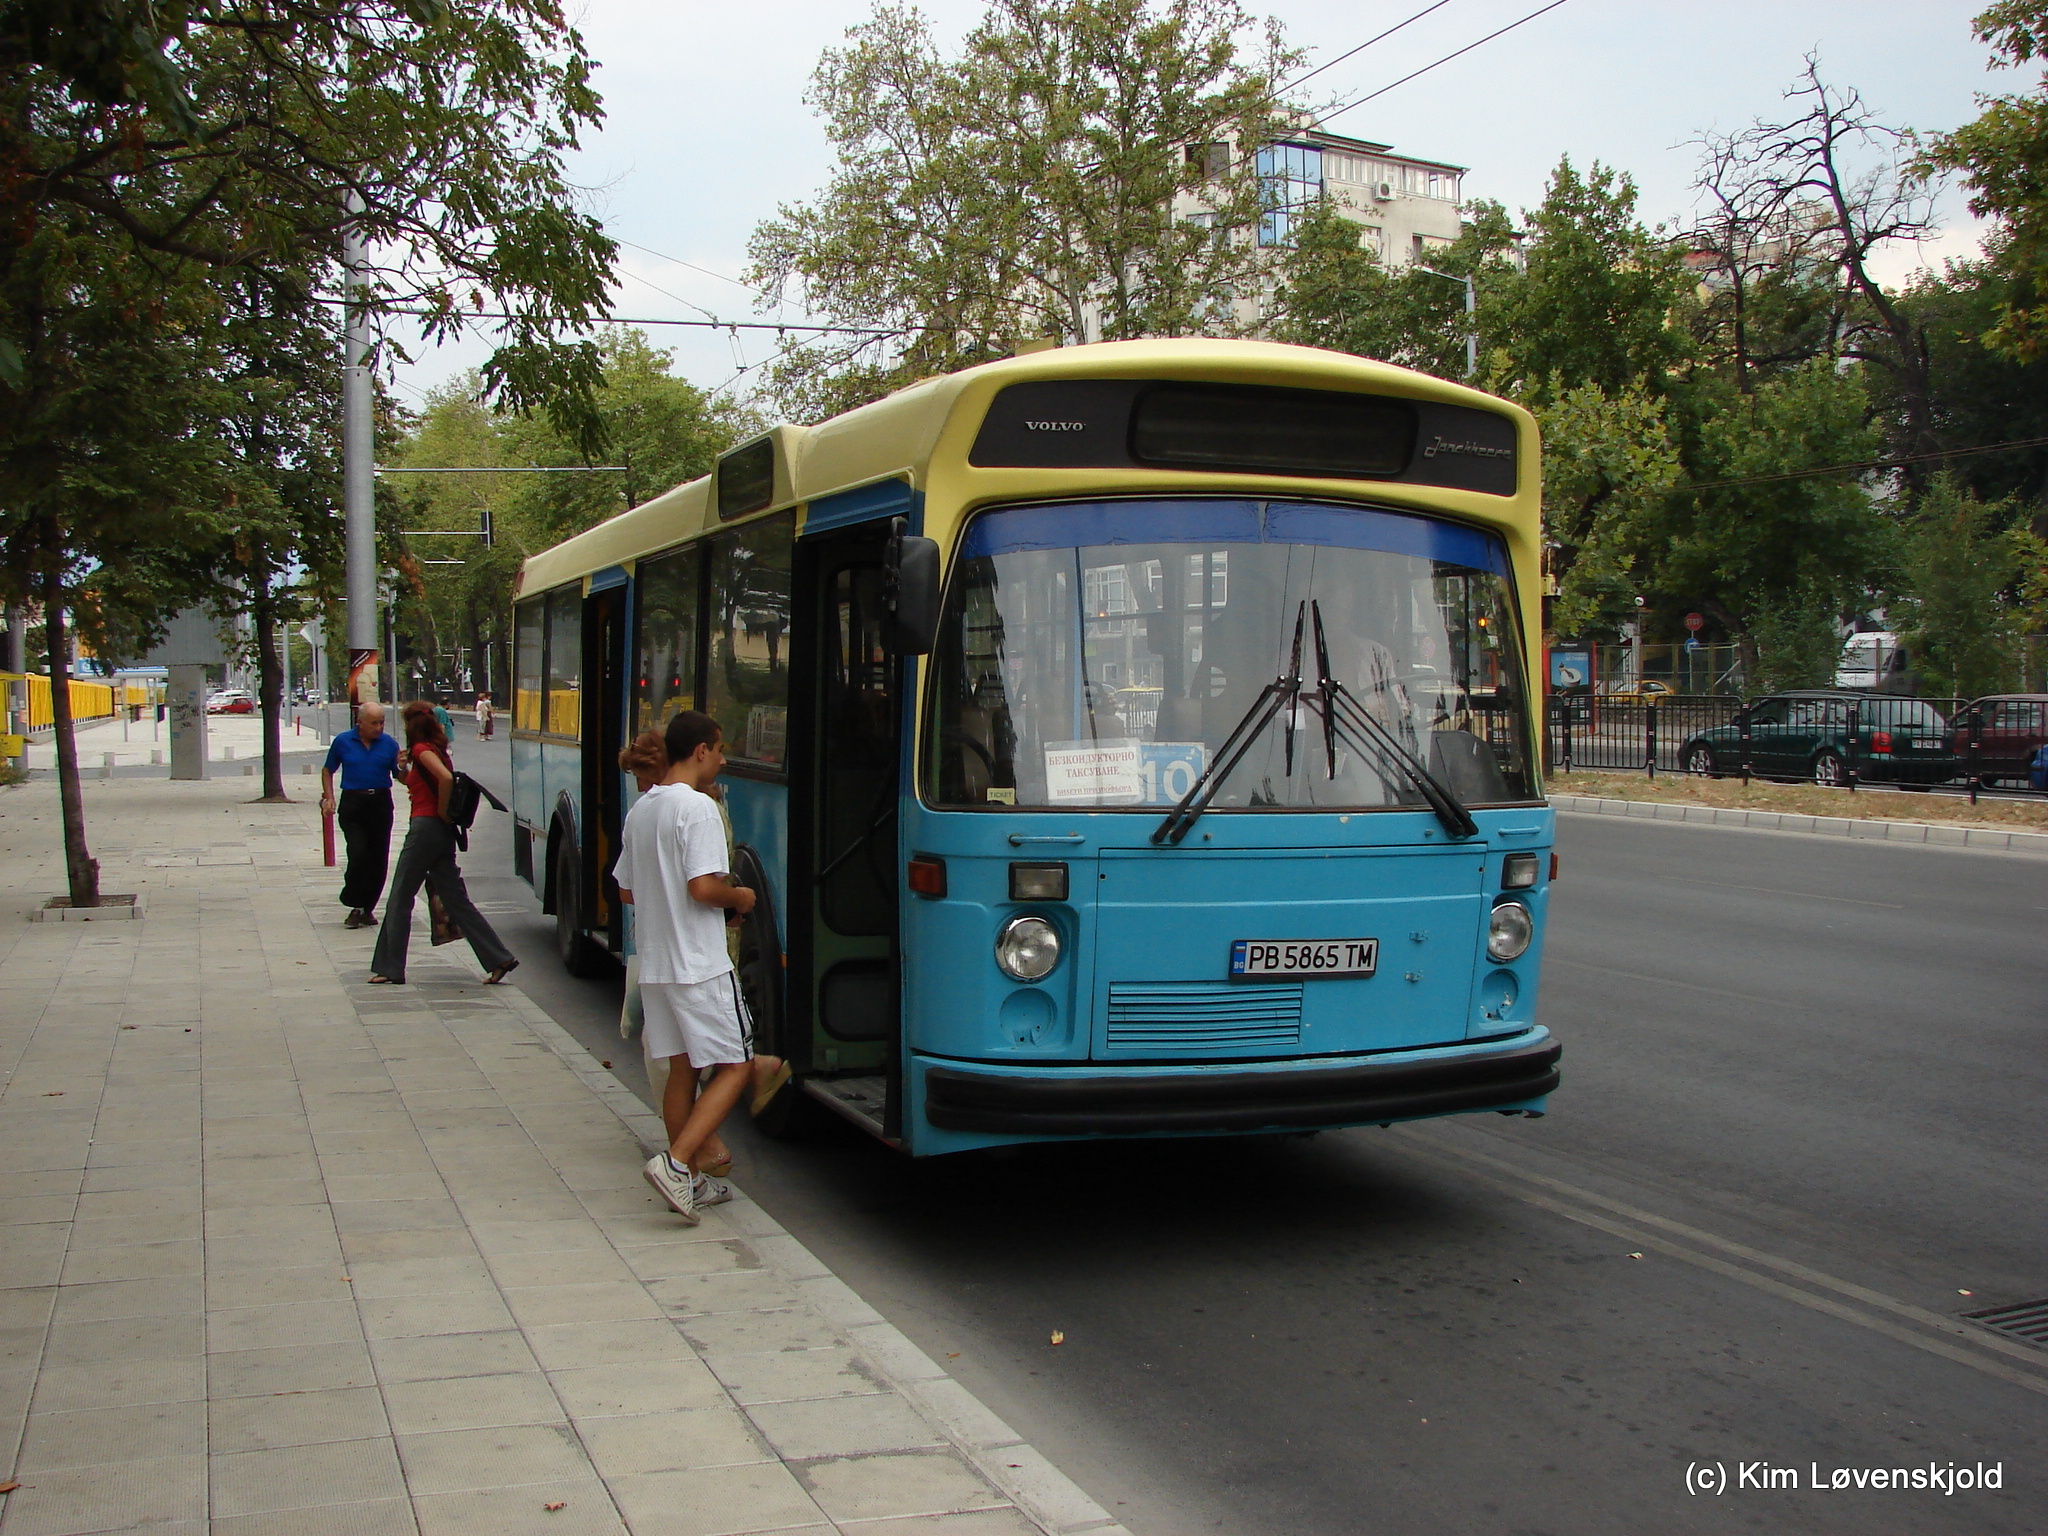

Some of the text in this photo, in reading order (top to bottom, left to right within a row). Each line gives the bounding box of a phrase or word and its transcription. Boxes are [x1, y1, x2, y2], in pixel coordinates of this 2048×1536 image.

[1025, 421, 1084, 431] VOLVO
[1686, 618, 1700, 626] STOP
[1049, 751, 1135, 766] БЕЗКОНДУКТОРНО
[1065, 766, 1120, 778] ТАКСУВАНЕ
[1142, 760, 1197, 802] 10
[1233, 944, 1373, 970] BG PB 5865 TM
